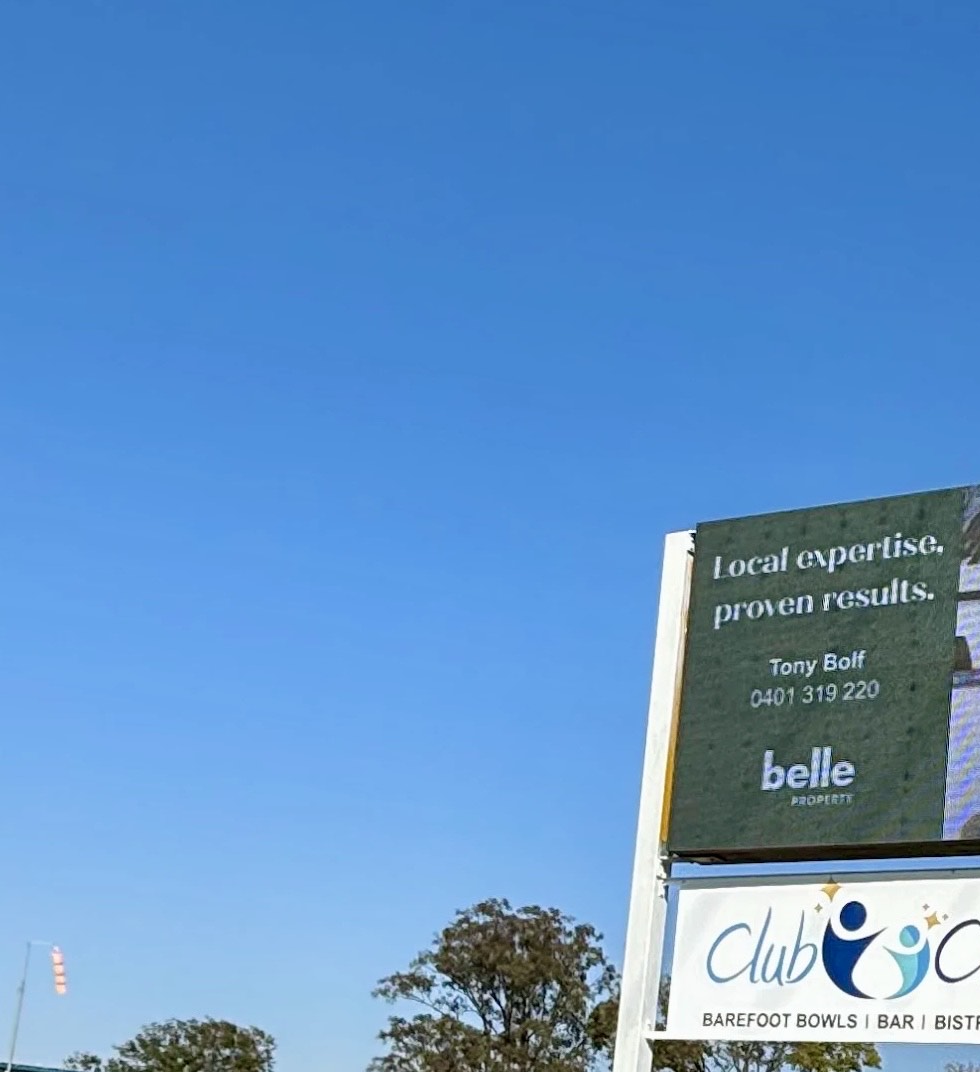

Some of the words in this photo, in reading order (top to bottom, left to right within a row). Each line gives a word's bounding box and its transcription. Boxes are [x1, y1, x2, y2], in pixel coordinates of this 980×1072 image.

[713, 546, 789, 580] Local
[796, 532, 945, 574] expertise.
[714, 592, 814, 630] proven
[821, 577, 935, 613] results.
[769, 657, 818, 678] Tony
[823, 650, 868, 673] Bolf
[750, 687, 795, 708] 0401
[802, 682, 837, 704] 319
[843, 679, 880, 702] 220
[761, 746, 856, 791] belle
[706, 906, 818, 986] Club
[702, 1012, 792, 1028] BAREFOOT
[795, 1013, 858, 1029] BOWLS
[877, 1014, 914, 1030] BAR
